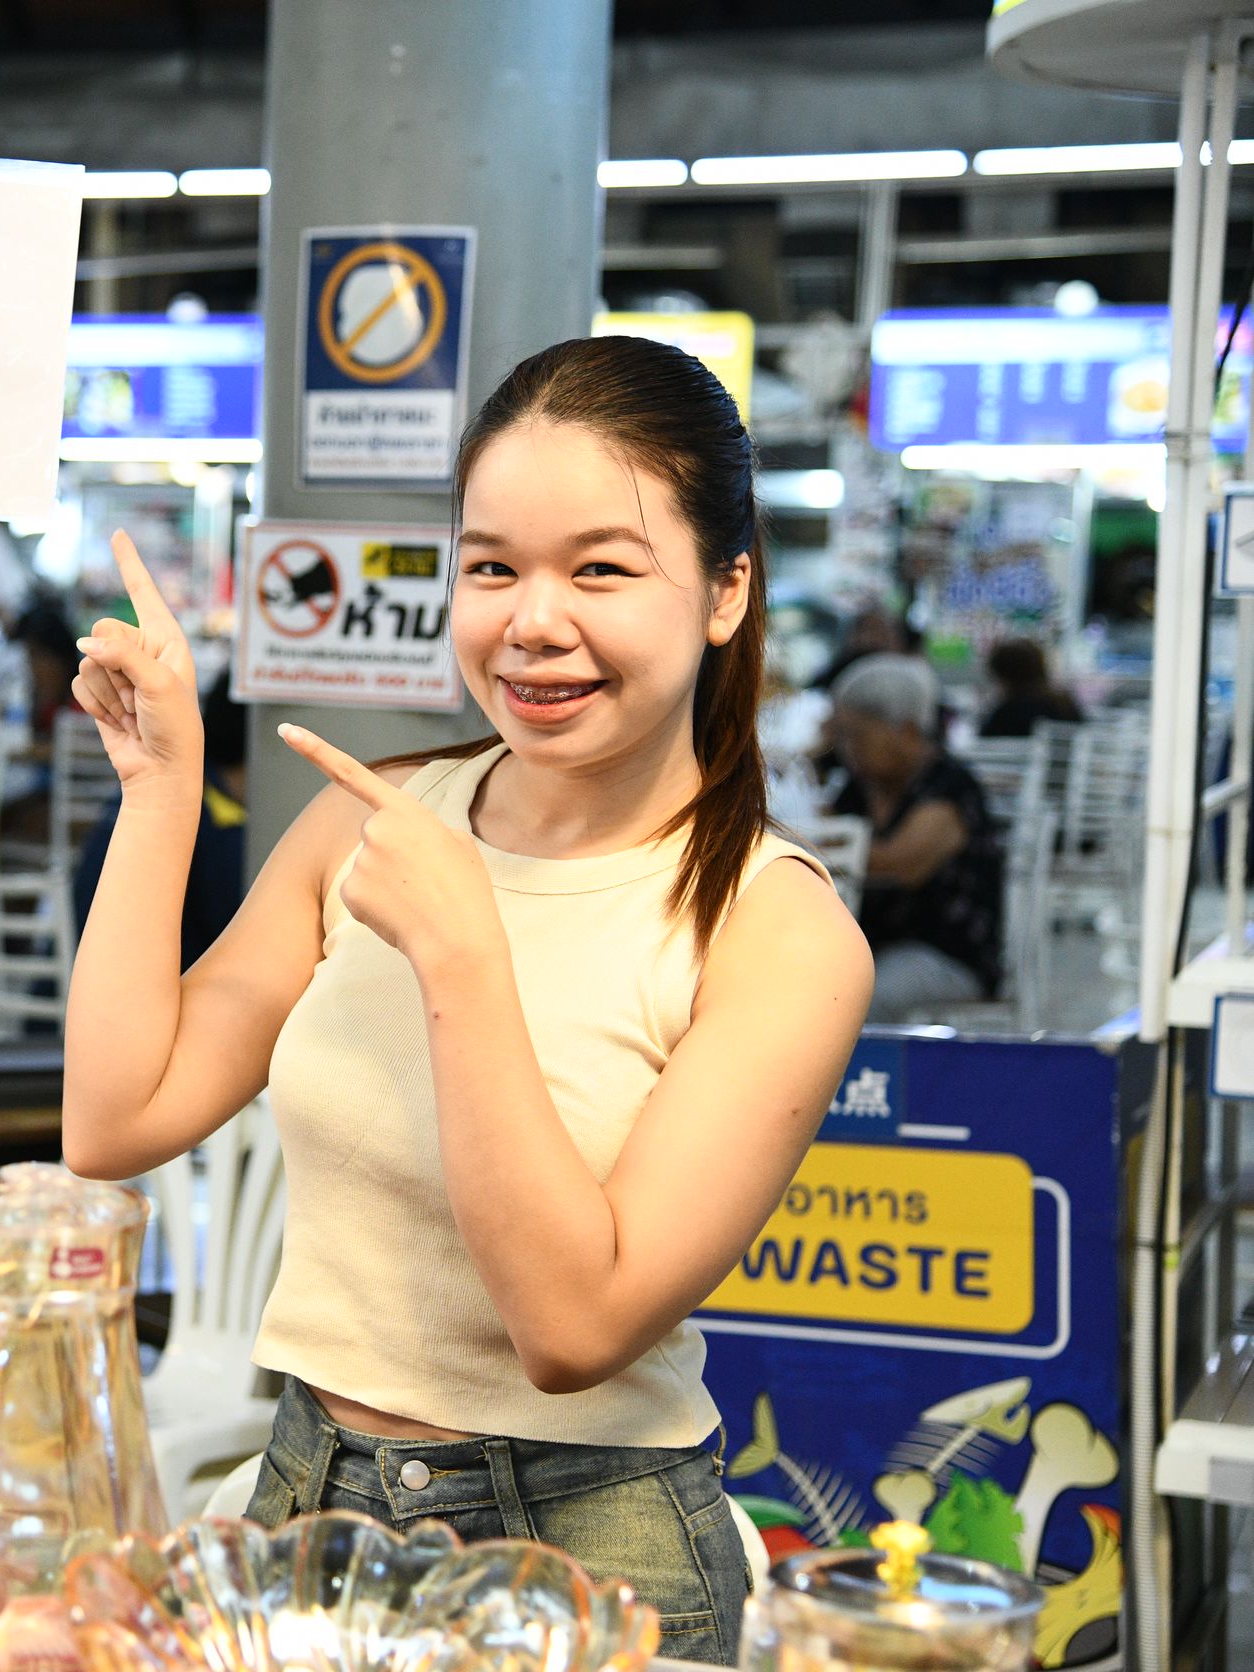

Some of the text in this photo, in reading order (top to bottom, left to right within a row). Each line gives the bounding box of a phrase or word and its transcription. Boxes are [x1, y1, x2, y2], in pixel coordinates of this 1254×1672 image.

[341, 580, 448, 641] ห้าม
[784, 1182, 930, 1225] อาหาร
[742, 1234, 992, 1300] WASTE
